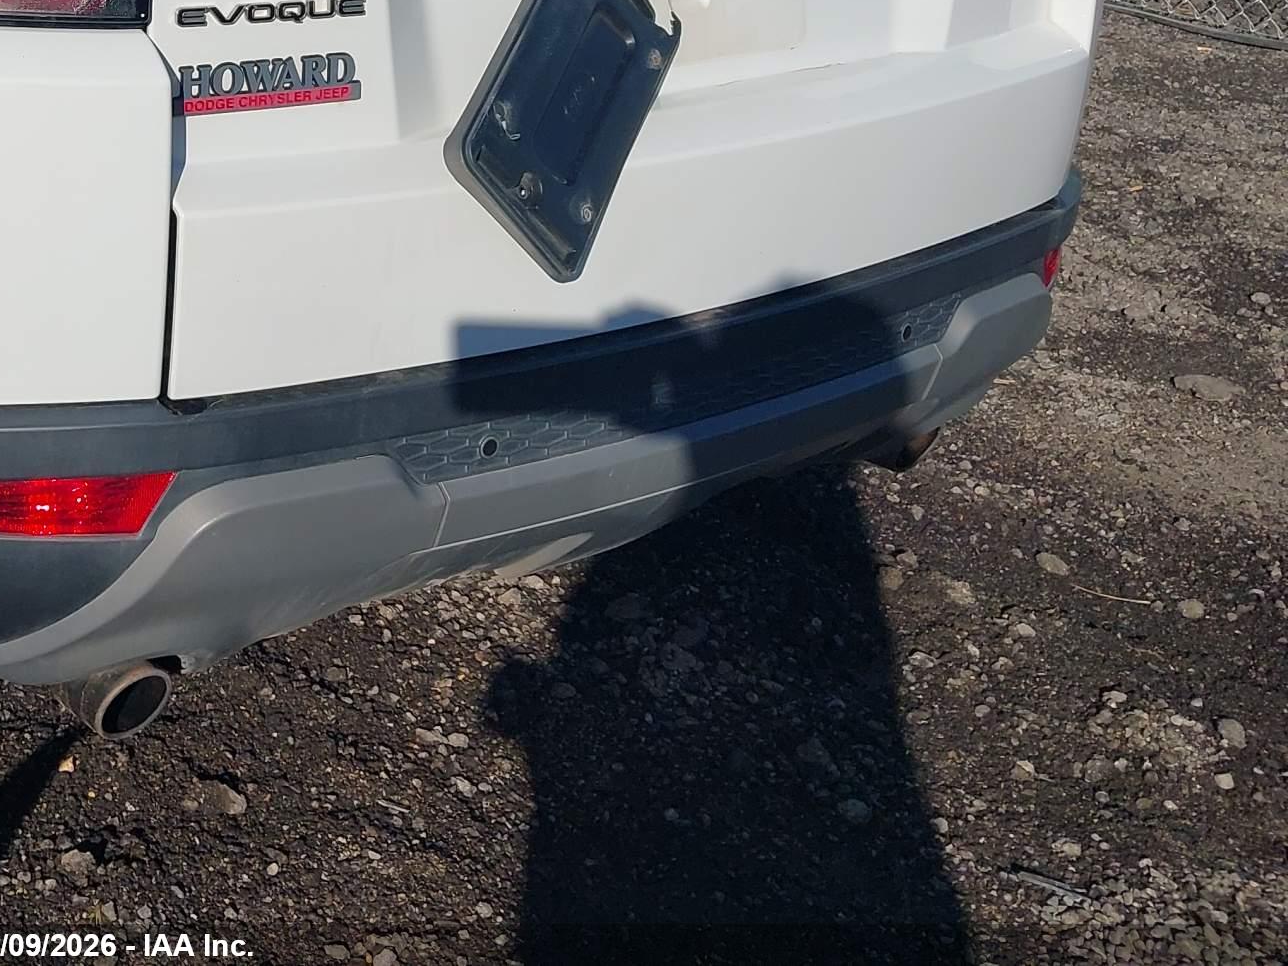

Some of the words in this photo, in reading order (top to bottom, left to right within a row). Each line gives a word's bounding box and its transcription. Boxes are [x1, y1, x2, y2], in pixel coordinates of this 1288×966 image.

[179, 52, 357, 98] HOWARD
[184, 98, 236, 113] DODGE
[238, 90, 312, 108] CHRYSLER
[315, 86, 349, 101] JEEP
